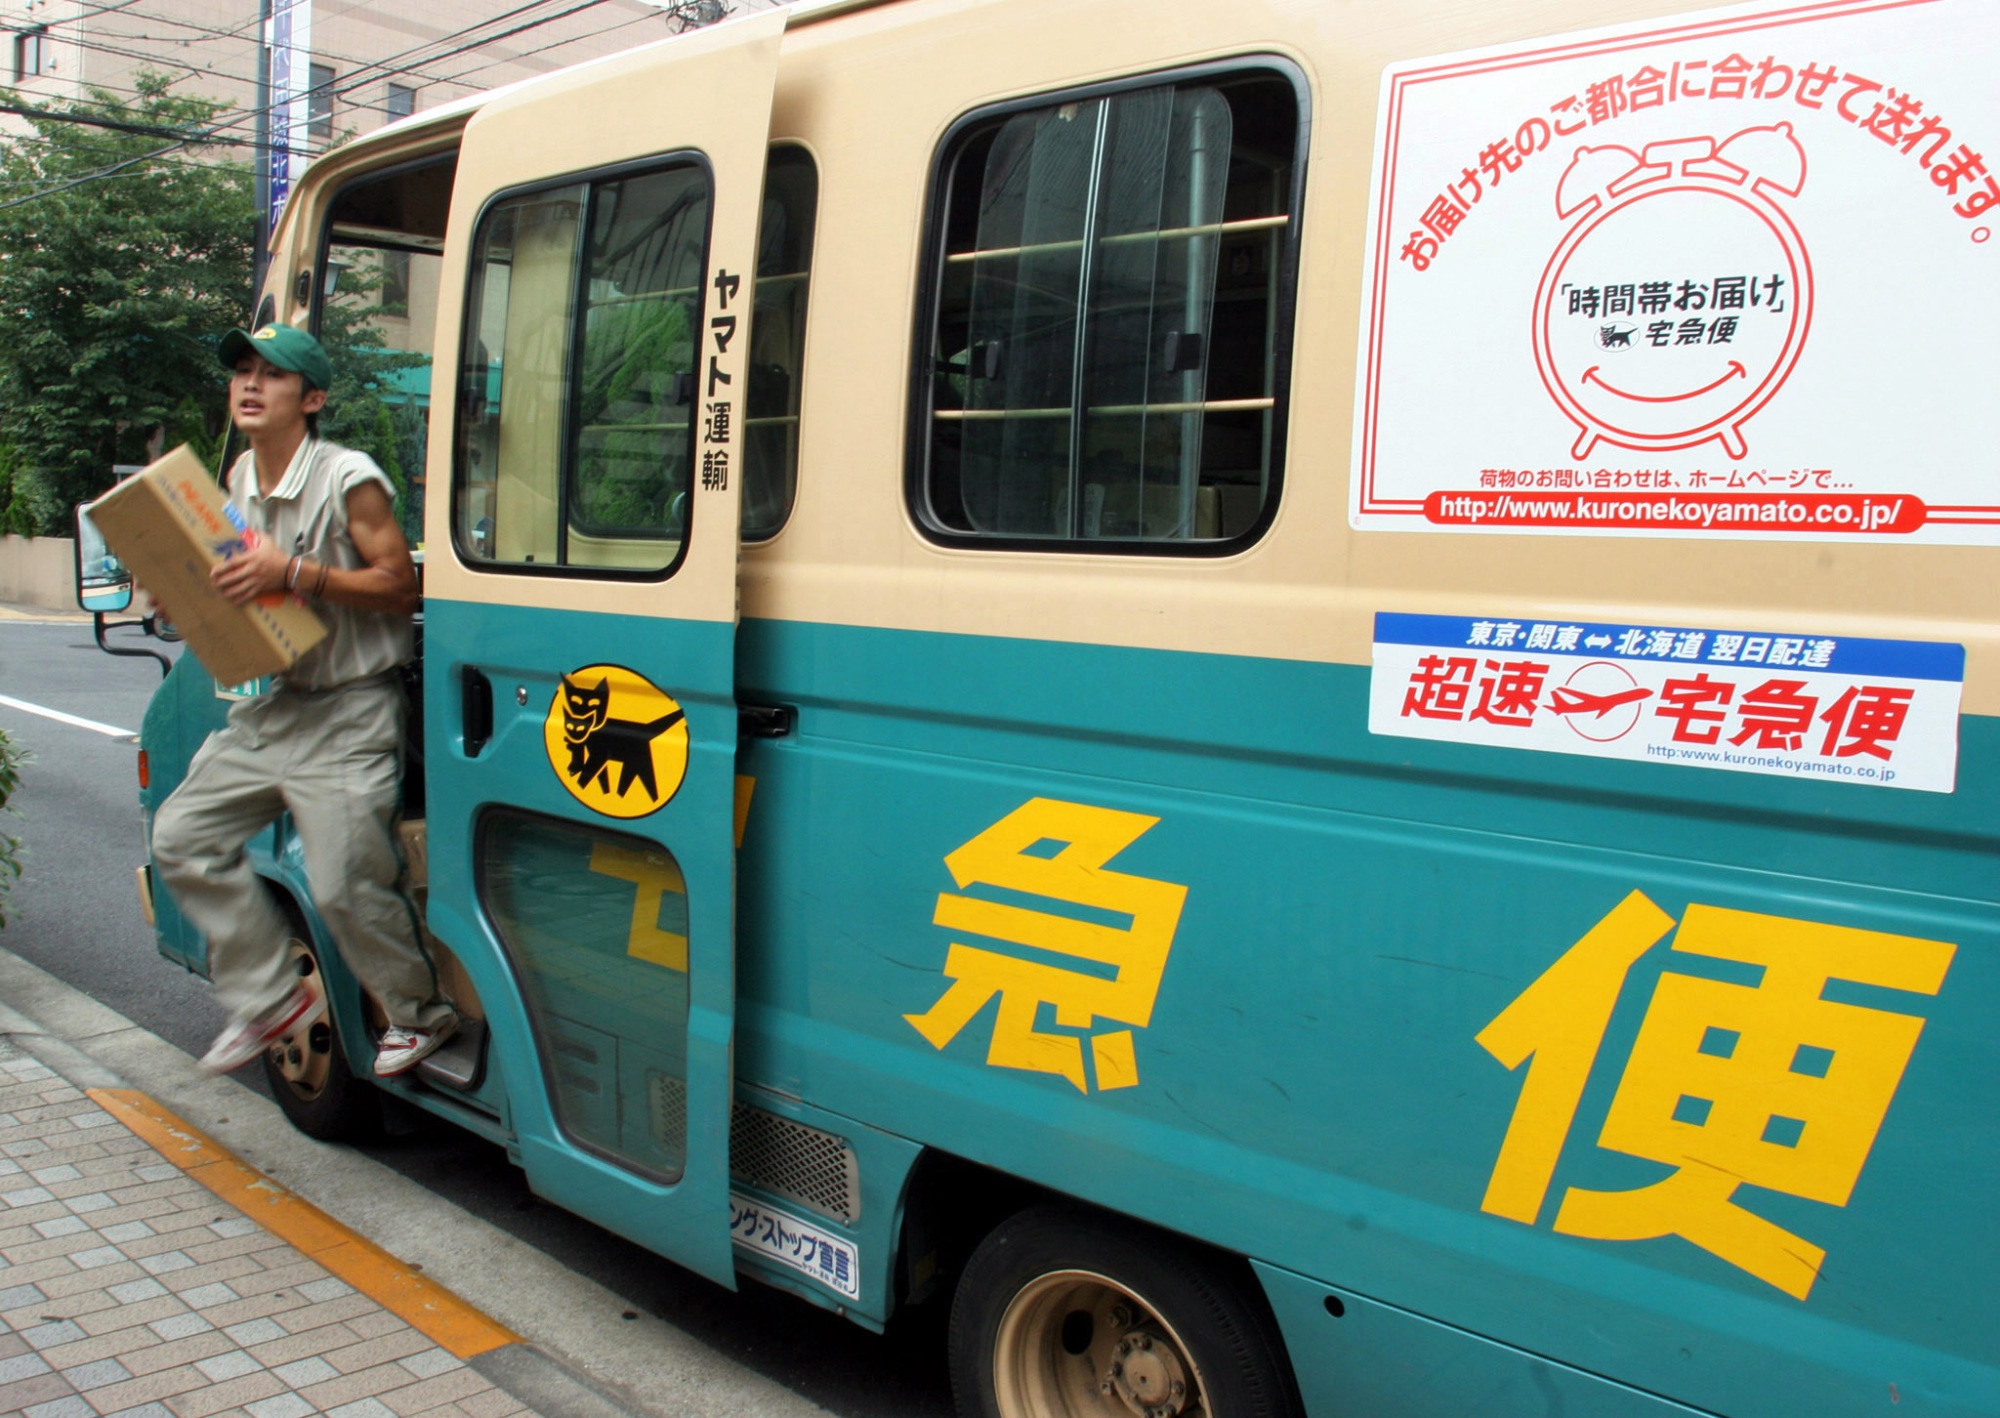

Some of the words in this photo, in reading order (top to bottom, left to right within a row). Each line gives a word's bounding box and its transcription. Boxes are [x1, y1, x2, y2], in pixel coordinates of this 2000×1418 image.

[1400, 53, 2000, 272] お届け先のご都合に合わせて送れます。
[1561, 273, 1786, 319] 「時間帯お届け」
[1645, 315, 1741, 348] 宅急便
[701, 268, 741, 492] ヤマト運輸
[1439, 496, 1904, 531] http://www.kuronekoyamato.co.jp/
[1614, 628, 1706, 660] 北海道
[1708, 634, 1837, 669] 翌日配達
[1400, 654, 1550, 729] 超速
[1654, 672, 1916, 763] 宅急便
[1646, 743, 1896, 782] http:www.kuronekoyamato.co.jp
